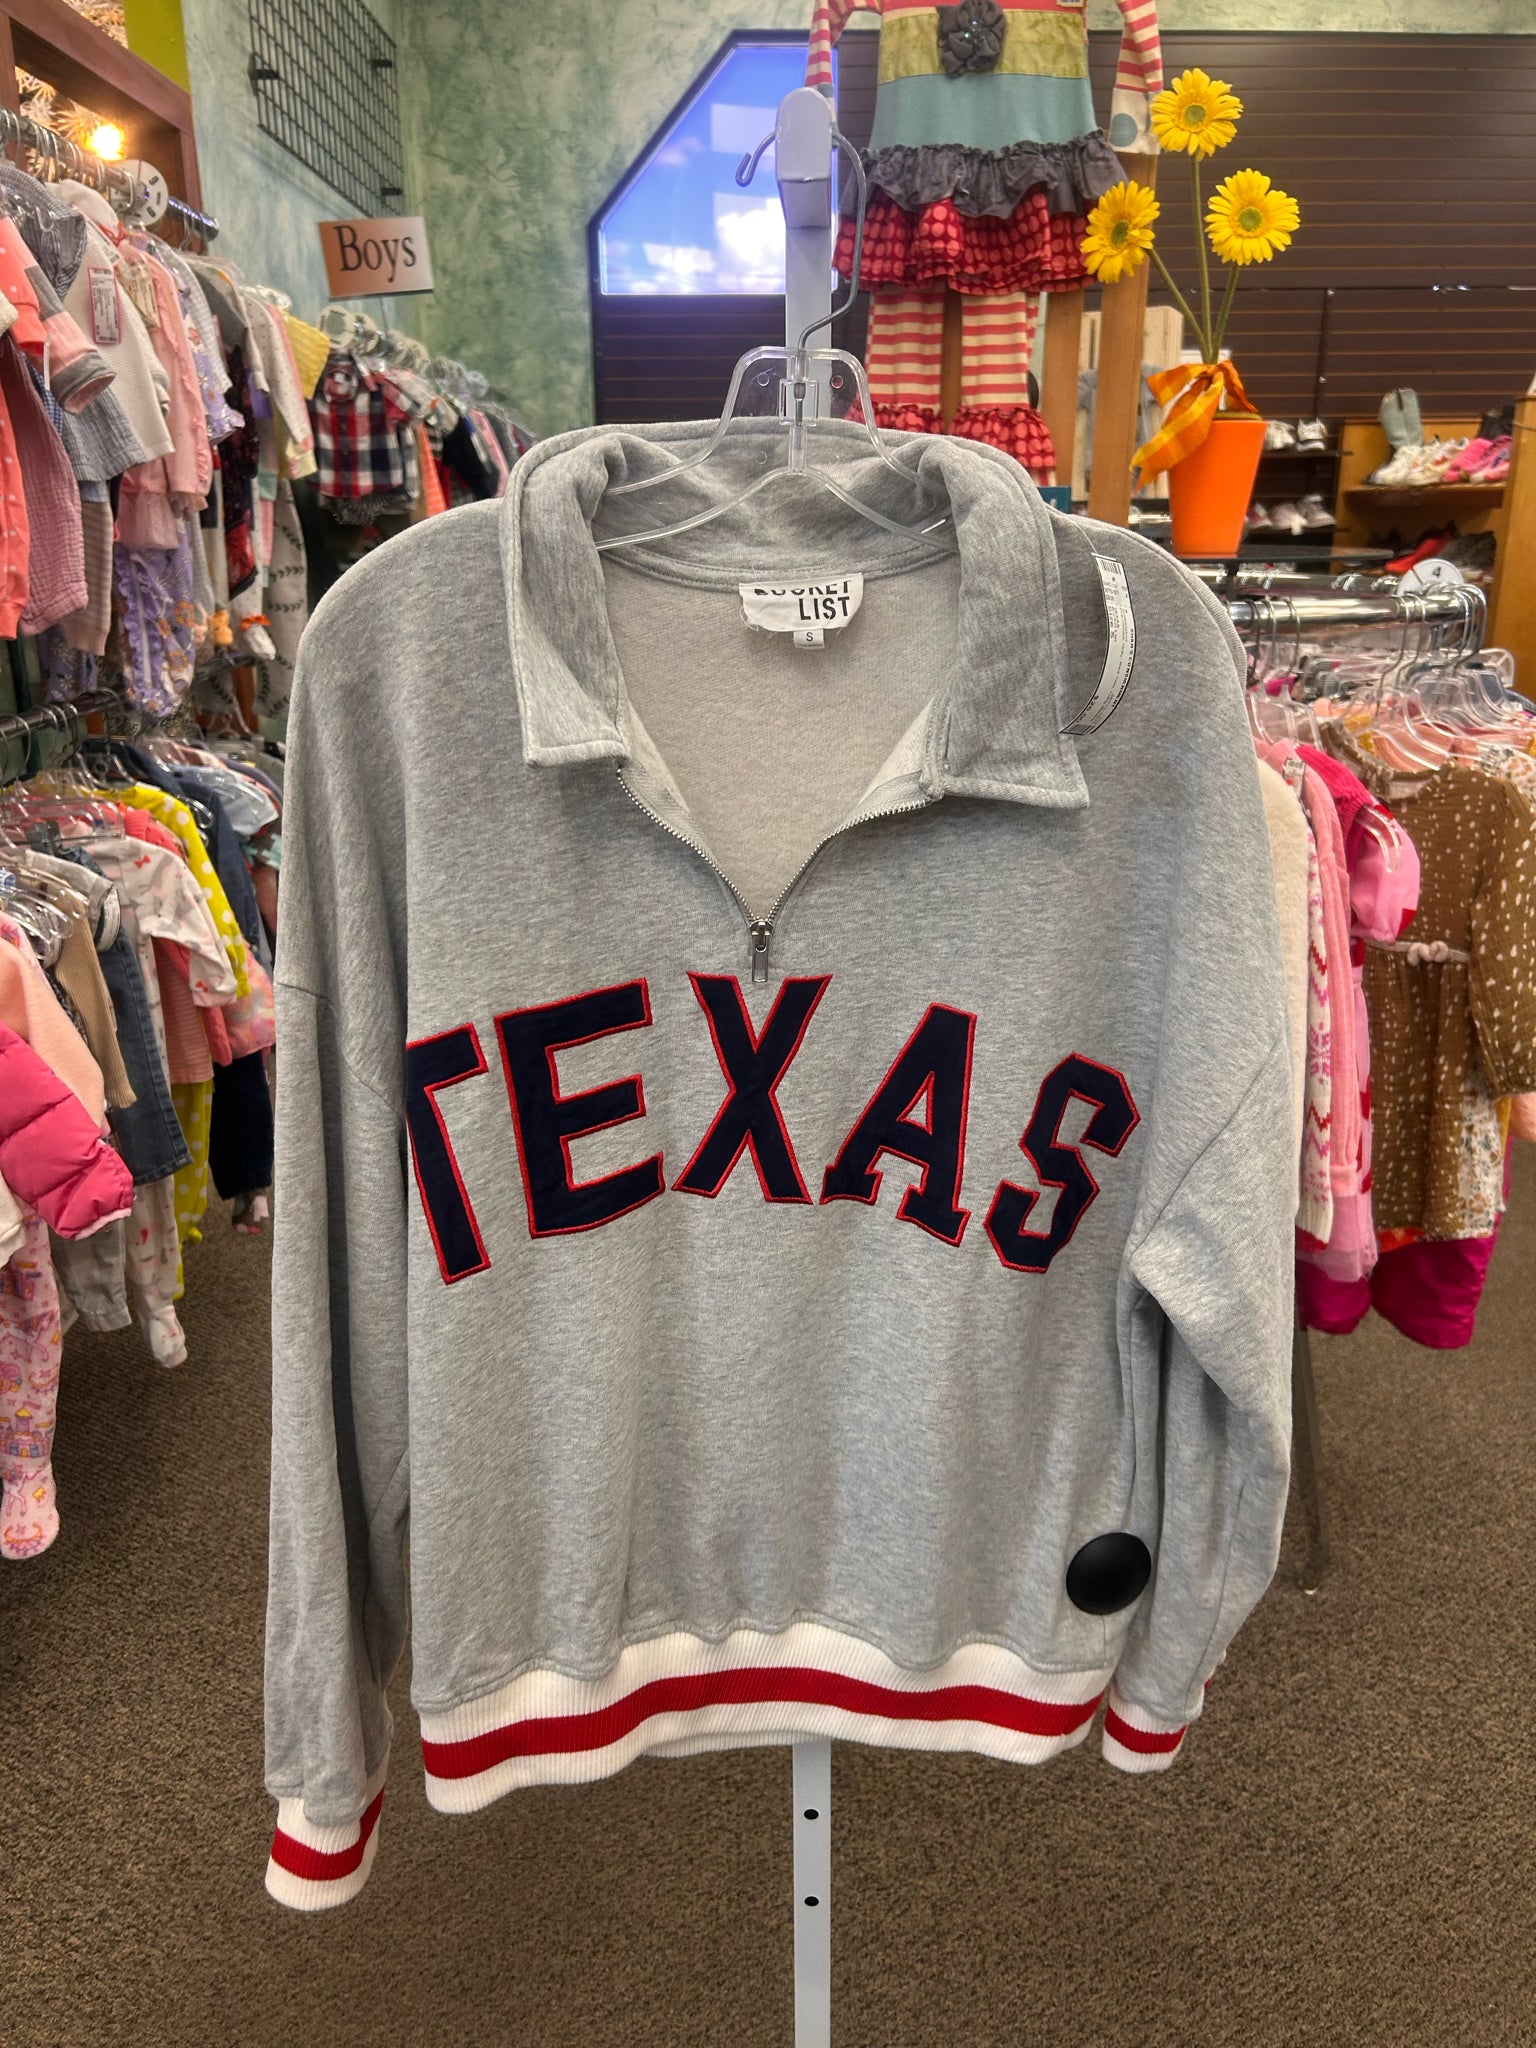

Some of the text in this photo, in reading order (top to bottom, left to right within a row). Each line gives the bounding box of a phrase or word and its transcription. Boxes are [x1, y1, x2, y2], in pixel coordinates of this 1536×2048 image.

[333, 225, 416, 283] Boys
[1432, 566, 1442, 578] 4
[799, 596, 850, 620] LIST
[806, 631, 814, 642] S
[406, 972, 1141, 1285] TEXAS
